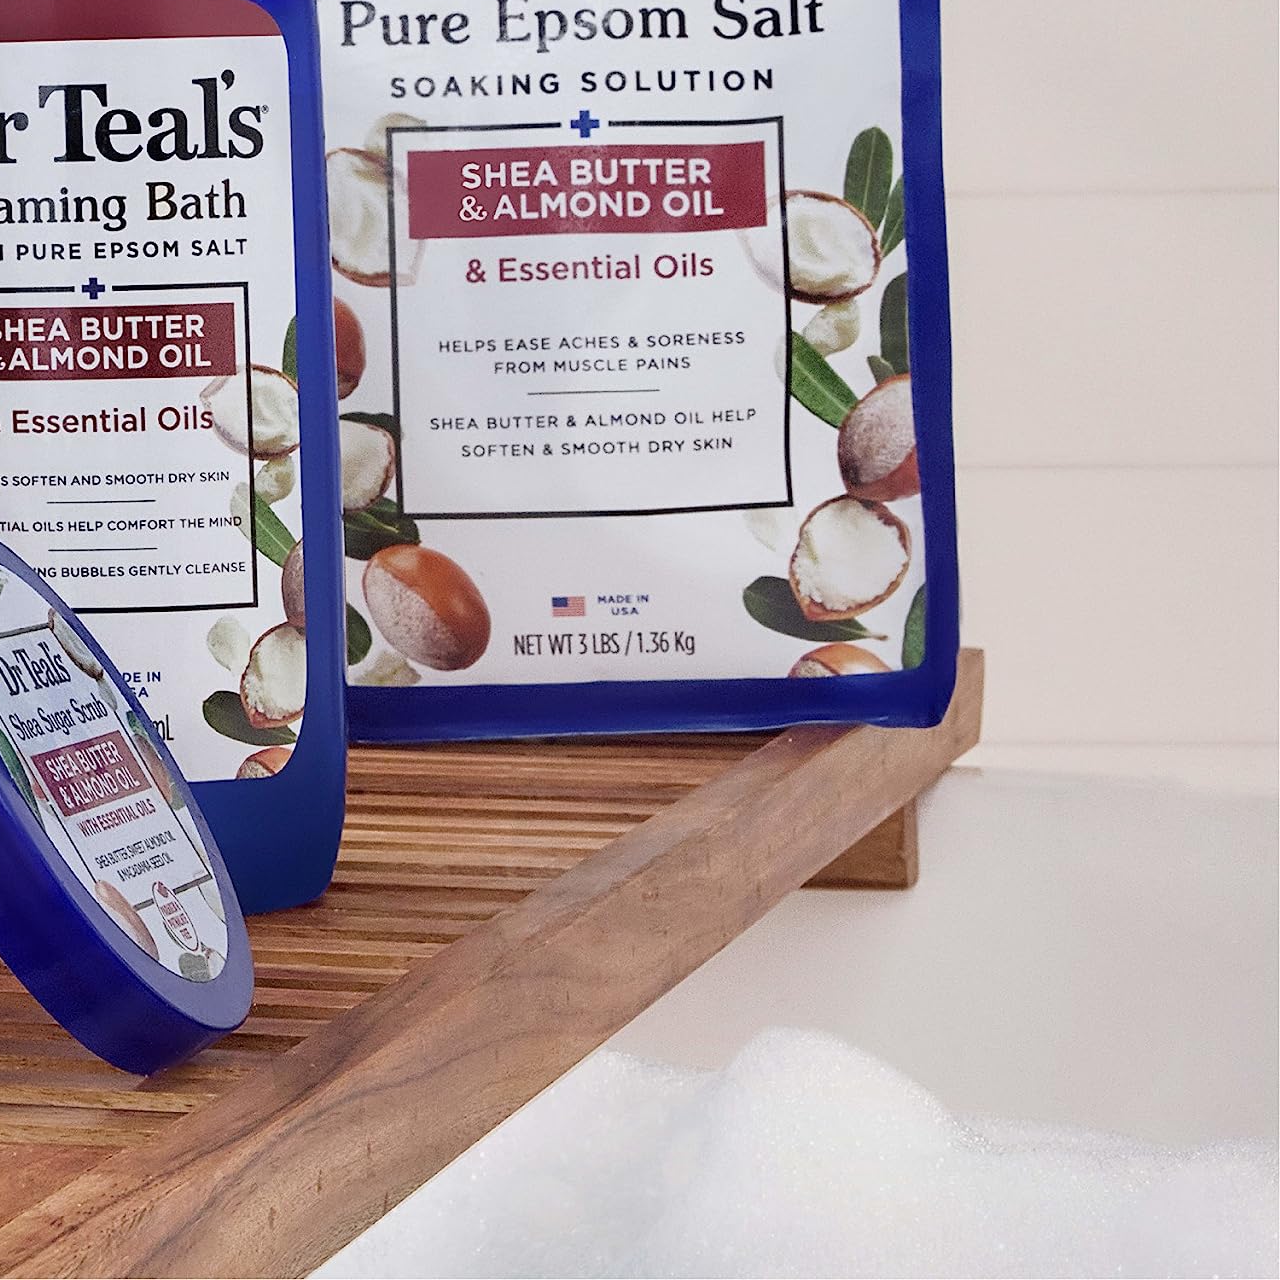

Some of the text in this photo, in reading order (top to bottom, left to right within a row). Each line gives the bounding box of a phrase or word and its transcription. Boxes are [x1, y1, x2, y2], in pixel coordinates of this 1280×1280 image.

[339, 0, 471, 48] Pure
[389, 67, 775, 99] SOAKING SOLUTION
[460, 157, 713, 189] SHEA BUTTER
[145, 179, 248, 222] Bath
[493, 190, 652, 221] ALMOND
[662, 189, 725, 218] OIL
[15, 242, 82, 261] PURE
[93, 240, 180, 260] EPSOM
[190, 238, 249, 257] SALT
[465, 251, 715, 284] & Essential Oils
[81, 313, 206, 341] BUTTER
[438, 330, 747, 354] HELPS EASE ACHES & SORENESS
[158, 343, 212, 369] OIL
[493, 356, 692, 375] FROM MUSCLE PAINS
[12, 405, 147, 434] Essential
[157, 404, 214, 432] Oils
[429, 407, 757, 431] SHEA BUTTER & ALMOND OIL HELP
[461, 436, 734, 458] SOFTEN & SMOOTH DRY SKIN
[11, 474, 67, 487] SOFTEN
[70, 474, 102, 486] AND
[105, 472, 166, 486] SMOOTH
[169, 472, 197, 484] DRY
[199, 470, 231, 483] SKIN
[32, 520, 64, 533] OILS
[68, 520, 104, 532] HELP
[107, 519, 174, 531] COMFORT
[179, 517, 206, 530] THE
[208, 516, 243, 528] MIND
[61, 566, 125, 578] BUBBLES
[128, 564, 183, 578] GENTLY
[185, 561, 247, 575] CLEANSE
[596, 594, 650, 605] MADE IN
[610, 606, 640, 617] USA
[513, 630, 696, 657] NET WT 3 LBS / 1.36 Kg
[122, 671, 162, 683] DE IN
[8, 691, 109, 741] Shea Sugar Scrub
[44, 740, 124, 782] SHEA BUTTER
[68, 771, 120, 807] ALMOND
[114, 765, 141, 791] OIL
[76, 798, 157, 838] WITH ESSENTIAL OILS
